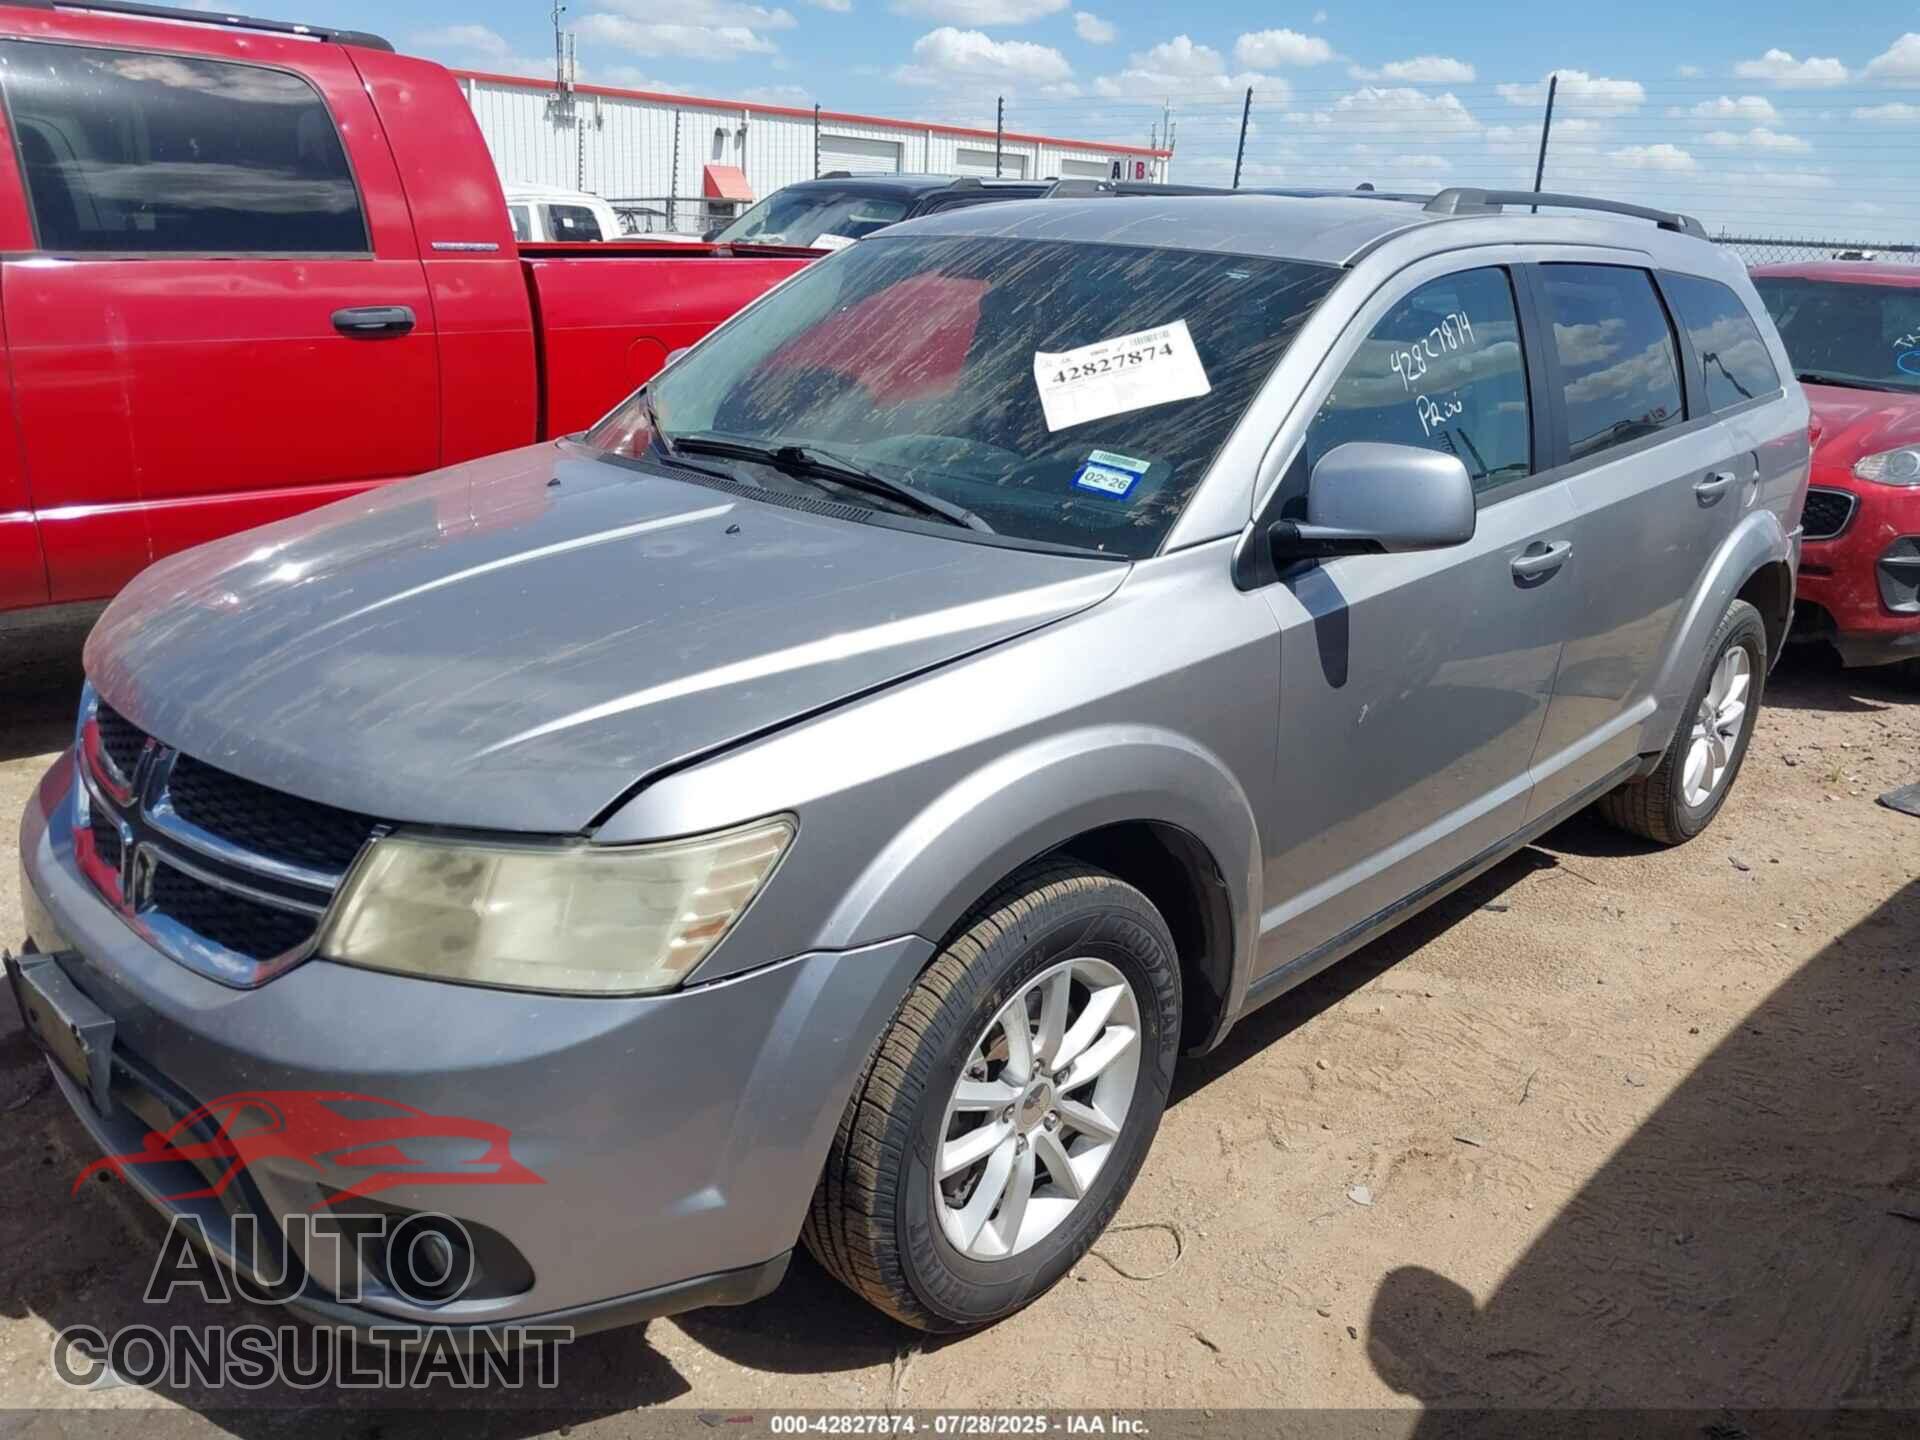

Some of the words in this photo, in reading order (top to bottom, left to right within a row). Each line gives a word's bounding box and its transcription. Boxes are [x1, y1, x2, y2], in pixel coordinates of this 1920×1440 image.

[1112, 161, 1120, 179] A
[1135, 161, 1145, 179] B
[1390, 311, 1476, 392] 42827874
[1052, 343, 1174, 383] 42827874
[1084, 471, 1129, 490] 02-26
